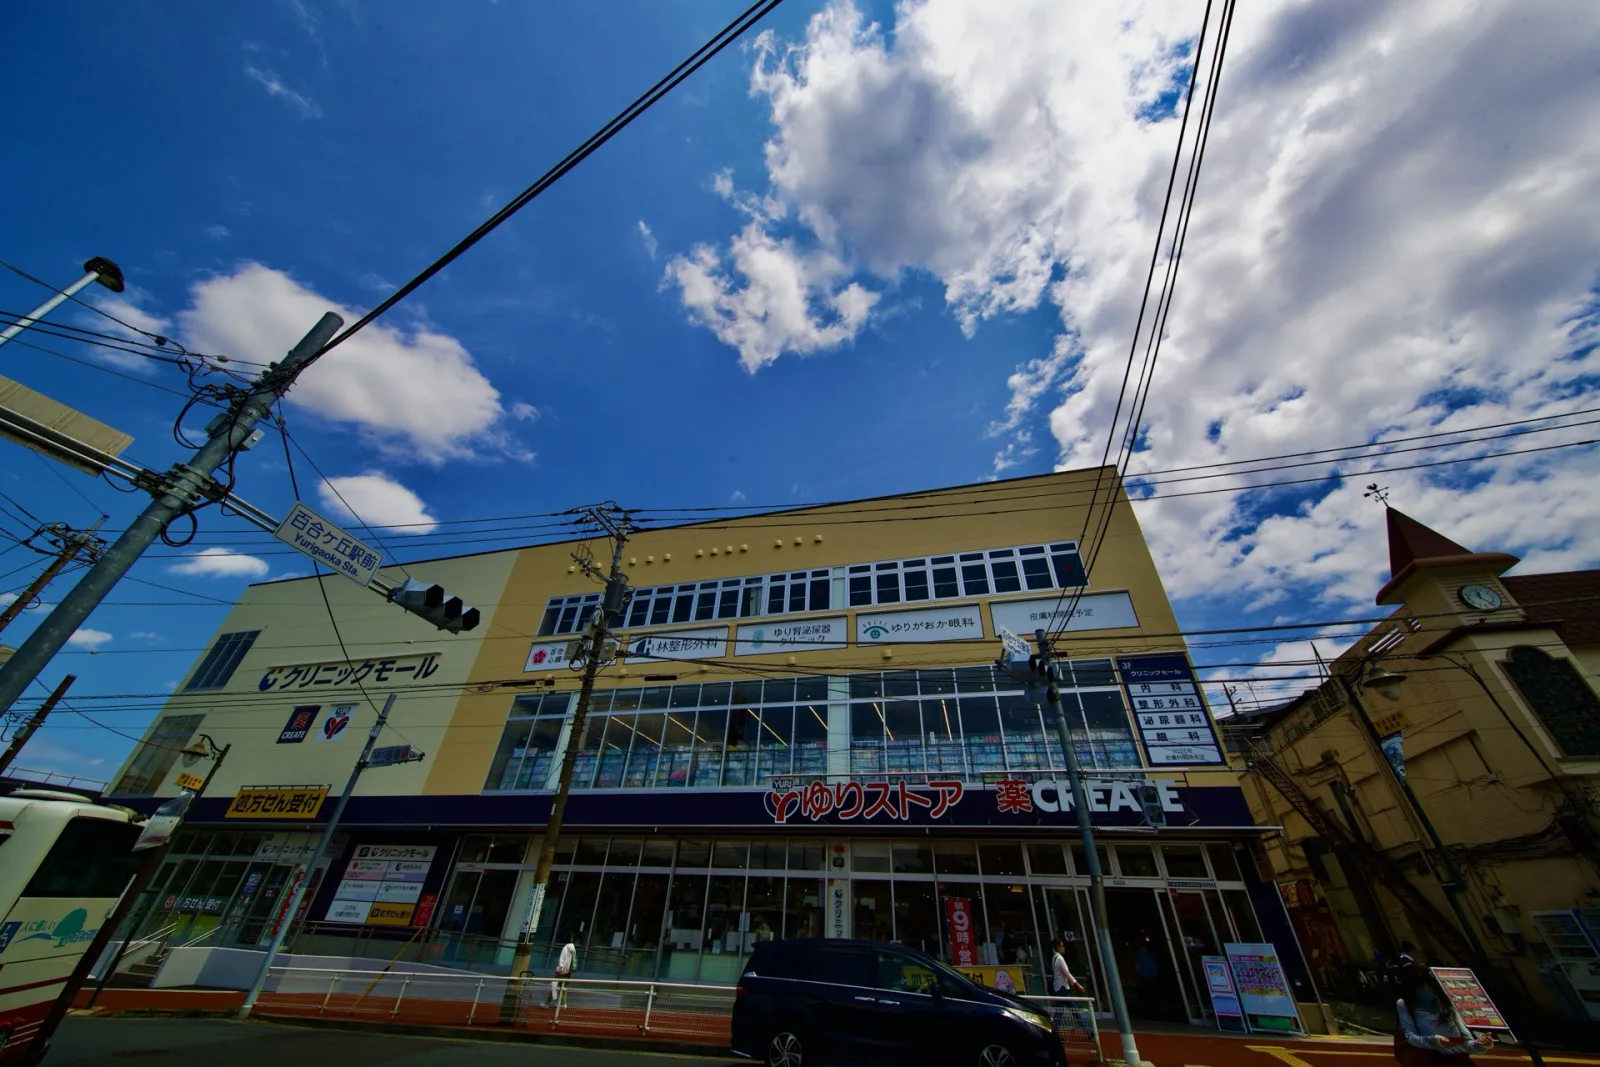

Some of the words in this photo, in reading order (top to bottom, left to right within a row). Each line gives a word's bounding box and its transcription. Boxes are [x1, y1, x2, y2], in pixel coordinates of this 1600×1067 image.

[294, 533, 342, 567] Yurigaoka
[341, 561, 358, 577] Sta.
[774, 624, 831, 637] ゆり腎泌尿器
[891, 617, 975, 632] ゆりがおか眼科
[780, 634, 825, 646] クリニック
[1121, 661, 1133, 670] 3F
[279, 655, 440, 690] クリニックモール
[1130, 669, 1182, 677] クリニックモール
[1138, 698, 1196, 709] 整形外科
[1143, 714, 1202, 725] 泌尿器科
[281, 730, 306, 740] CREATE
[773, 780, 793, 788] YURI
[801, 780, 964, 821] ゆりストア
[995, 778, 1034, 814] 薬
[1033, 778, 1185, 813] CREAE
[232, 793, 321, 814] 処方せん受付
[270, 844, 316, 854] クリニックモー
[379, 847, 430, 858] クリニックモール
